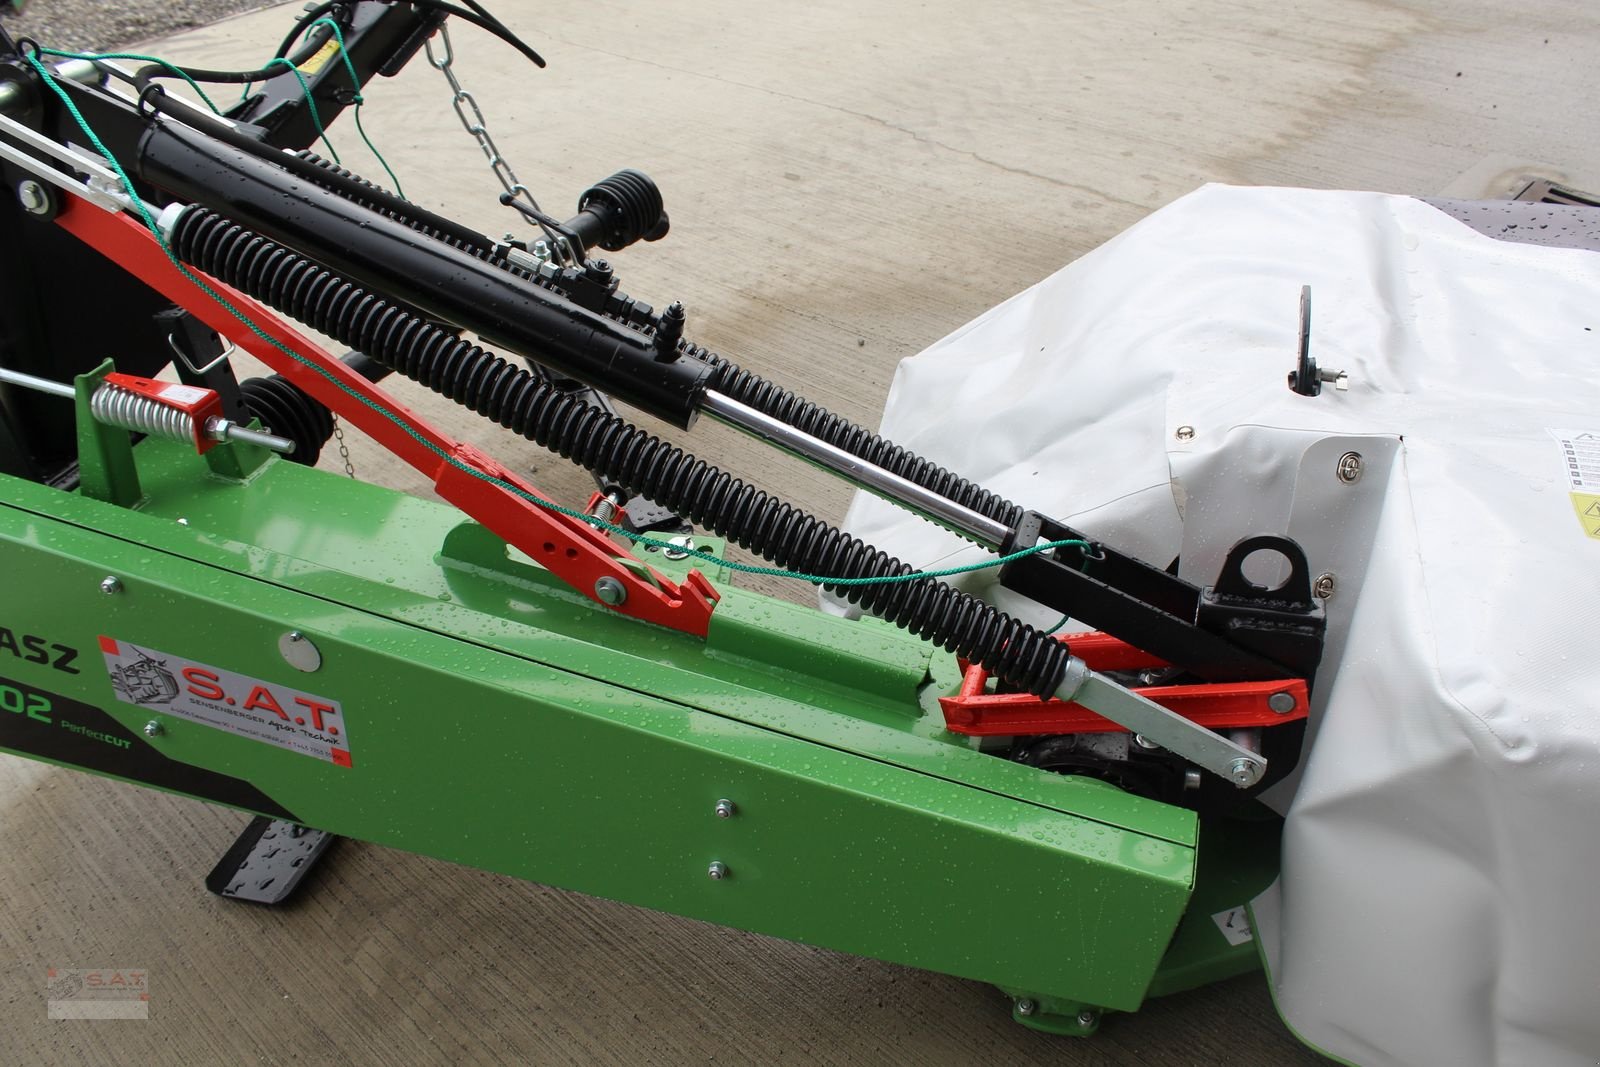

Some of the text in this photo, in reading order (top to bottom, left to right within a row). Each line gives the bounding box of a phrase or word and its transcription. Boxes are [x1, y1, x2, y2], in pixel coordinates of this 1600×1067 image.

[181, 666, 339, 736] S.A.T.
[189, 697, 265, 724] SENSENBERGER
[61, 720, 132, 749] PerfectCUT
